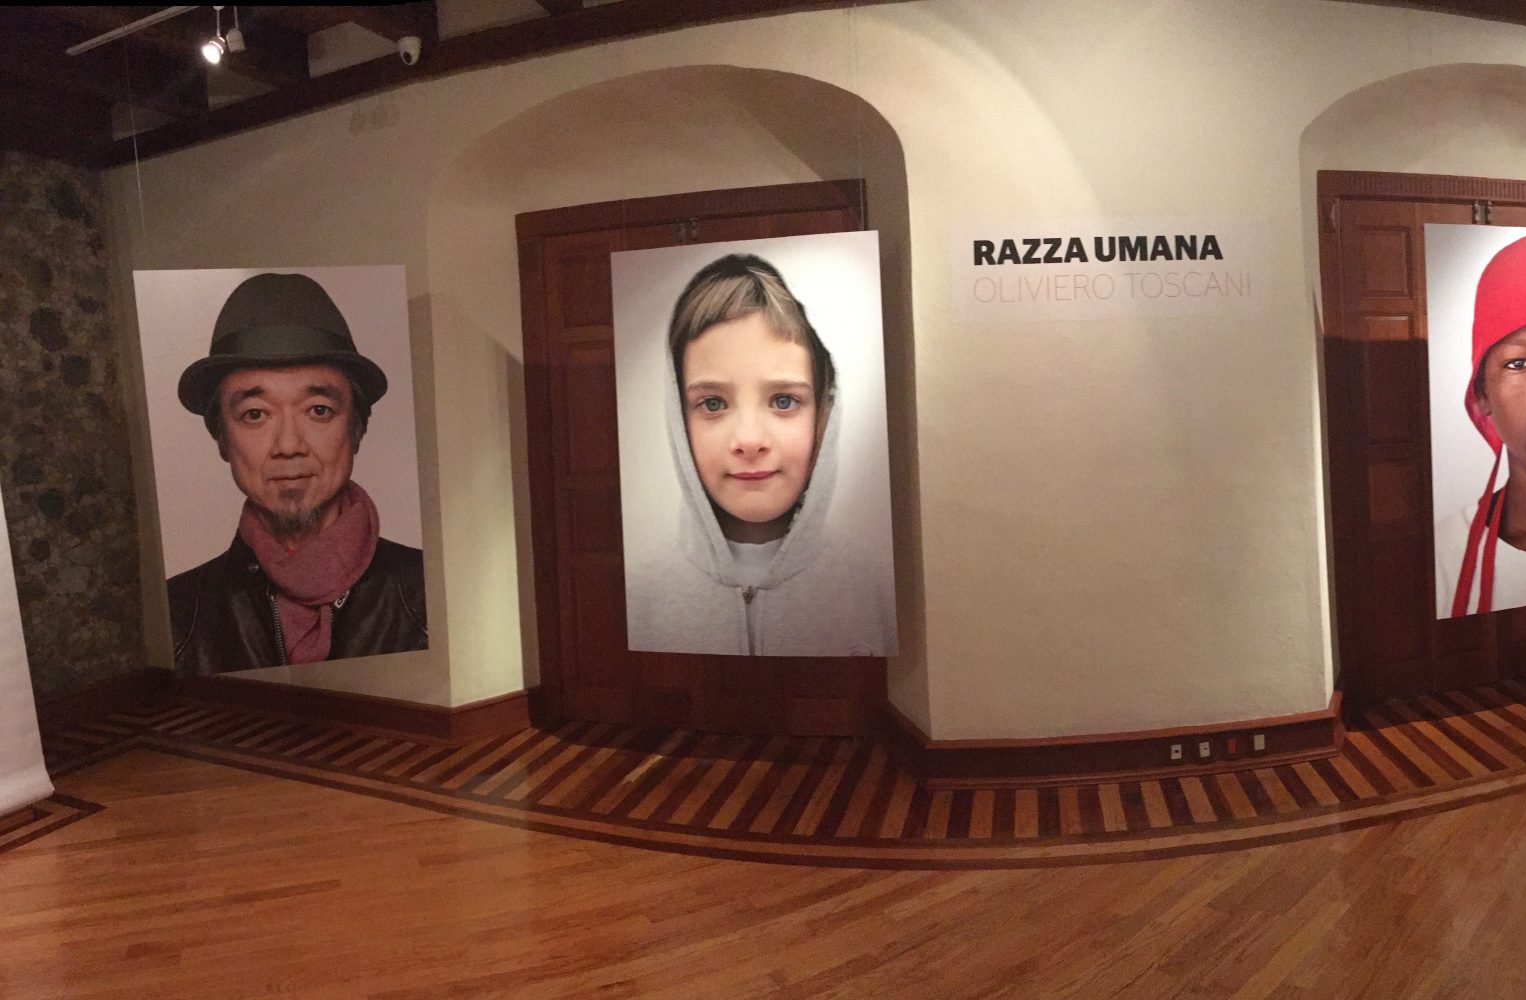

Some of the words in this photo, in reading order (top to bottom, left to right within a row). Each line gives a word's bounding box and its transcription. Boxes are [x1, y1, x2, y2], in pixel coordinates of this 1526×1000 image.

[973, 237, 1089, 266] RAZZA
[1094, 234, 1224, 263] UMANA
[973, 273, 1115, 303] OLIVIERO
[1122, 271, 1252, 300] TOSCANI
